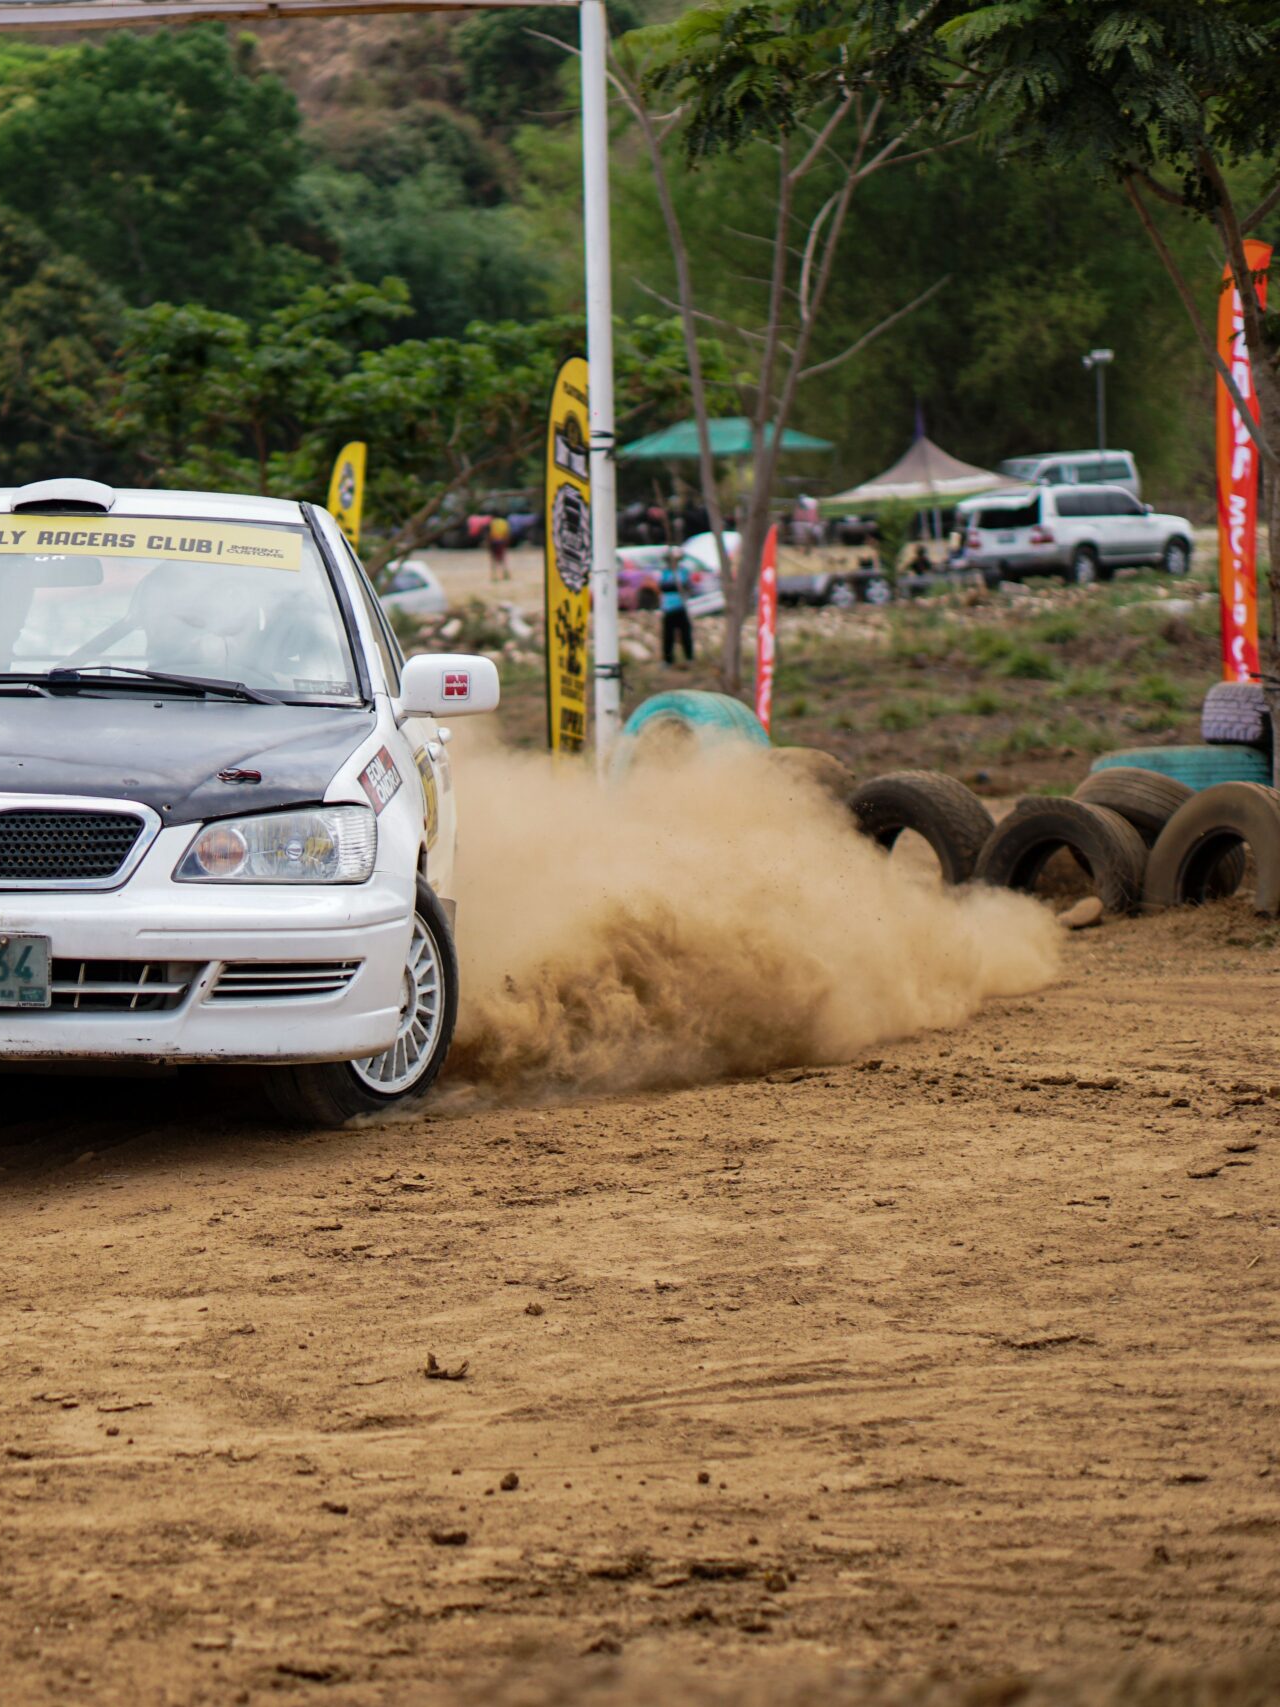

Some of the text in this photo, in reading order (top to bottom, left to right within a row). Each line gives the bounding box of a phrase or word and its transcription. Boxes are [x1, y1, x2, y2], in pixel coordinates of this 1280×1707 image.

[37, 530, 136, 548] RACERS
[147, 535, 213, 553] CLUB
[226, 549, 284, 559] CUSTOMS
[230, 544, 281, 554] IMPRINT
